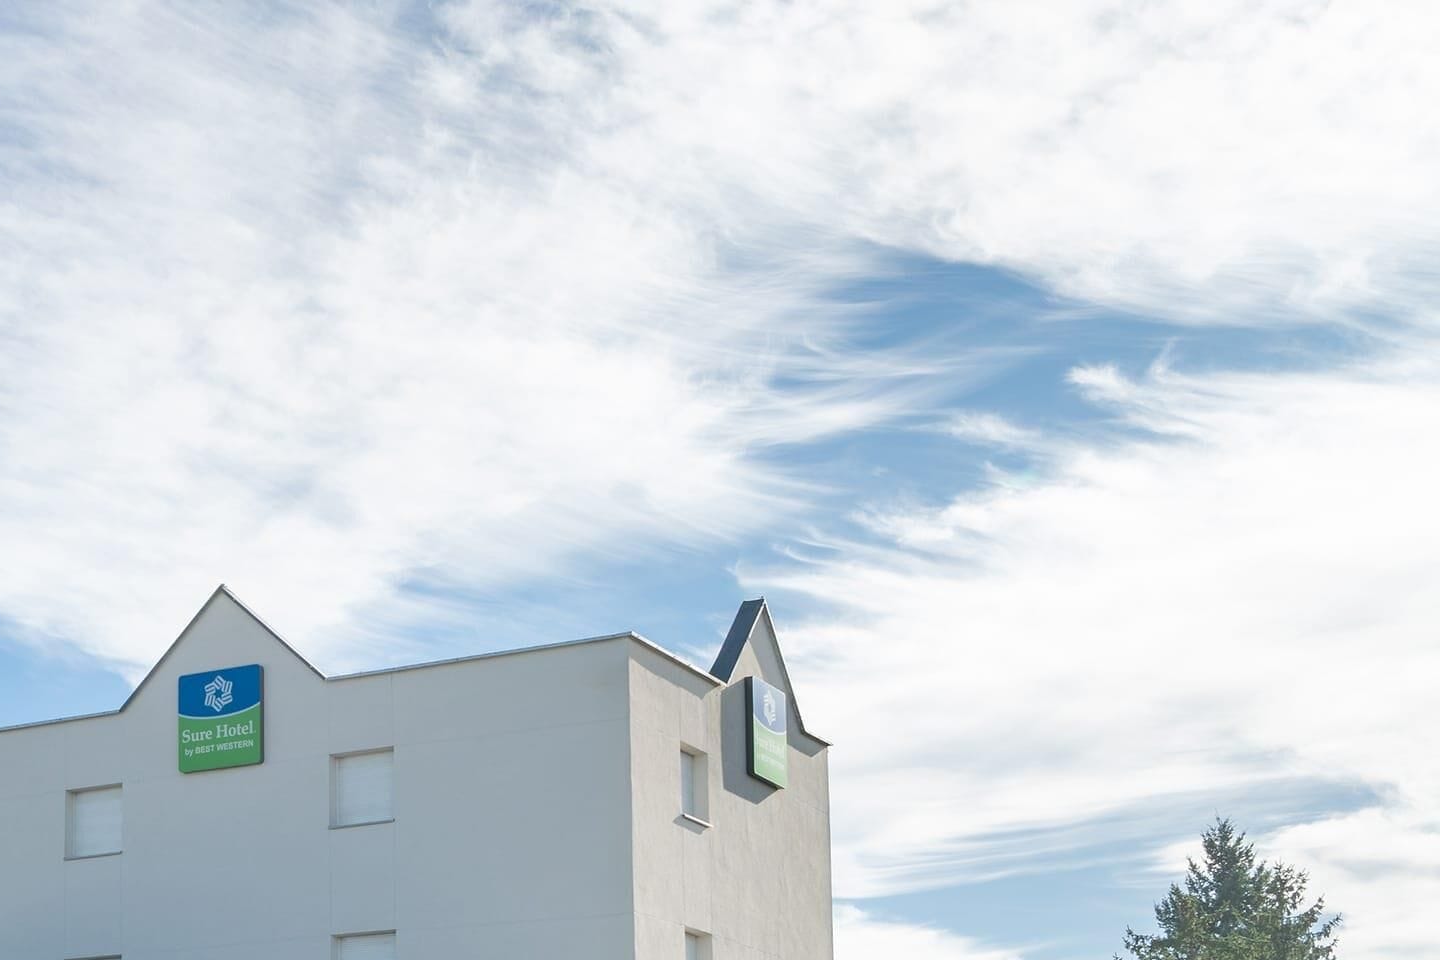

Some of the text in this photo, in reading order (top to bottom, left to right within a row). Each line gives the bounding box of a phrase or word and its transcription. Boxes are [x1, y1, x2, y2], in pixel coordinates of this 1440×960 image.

[182, 720, 253, 743] Sure Hotel
[185, 740, 254, 757] by BEST WESTERN
